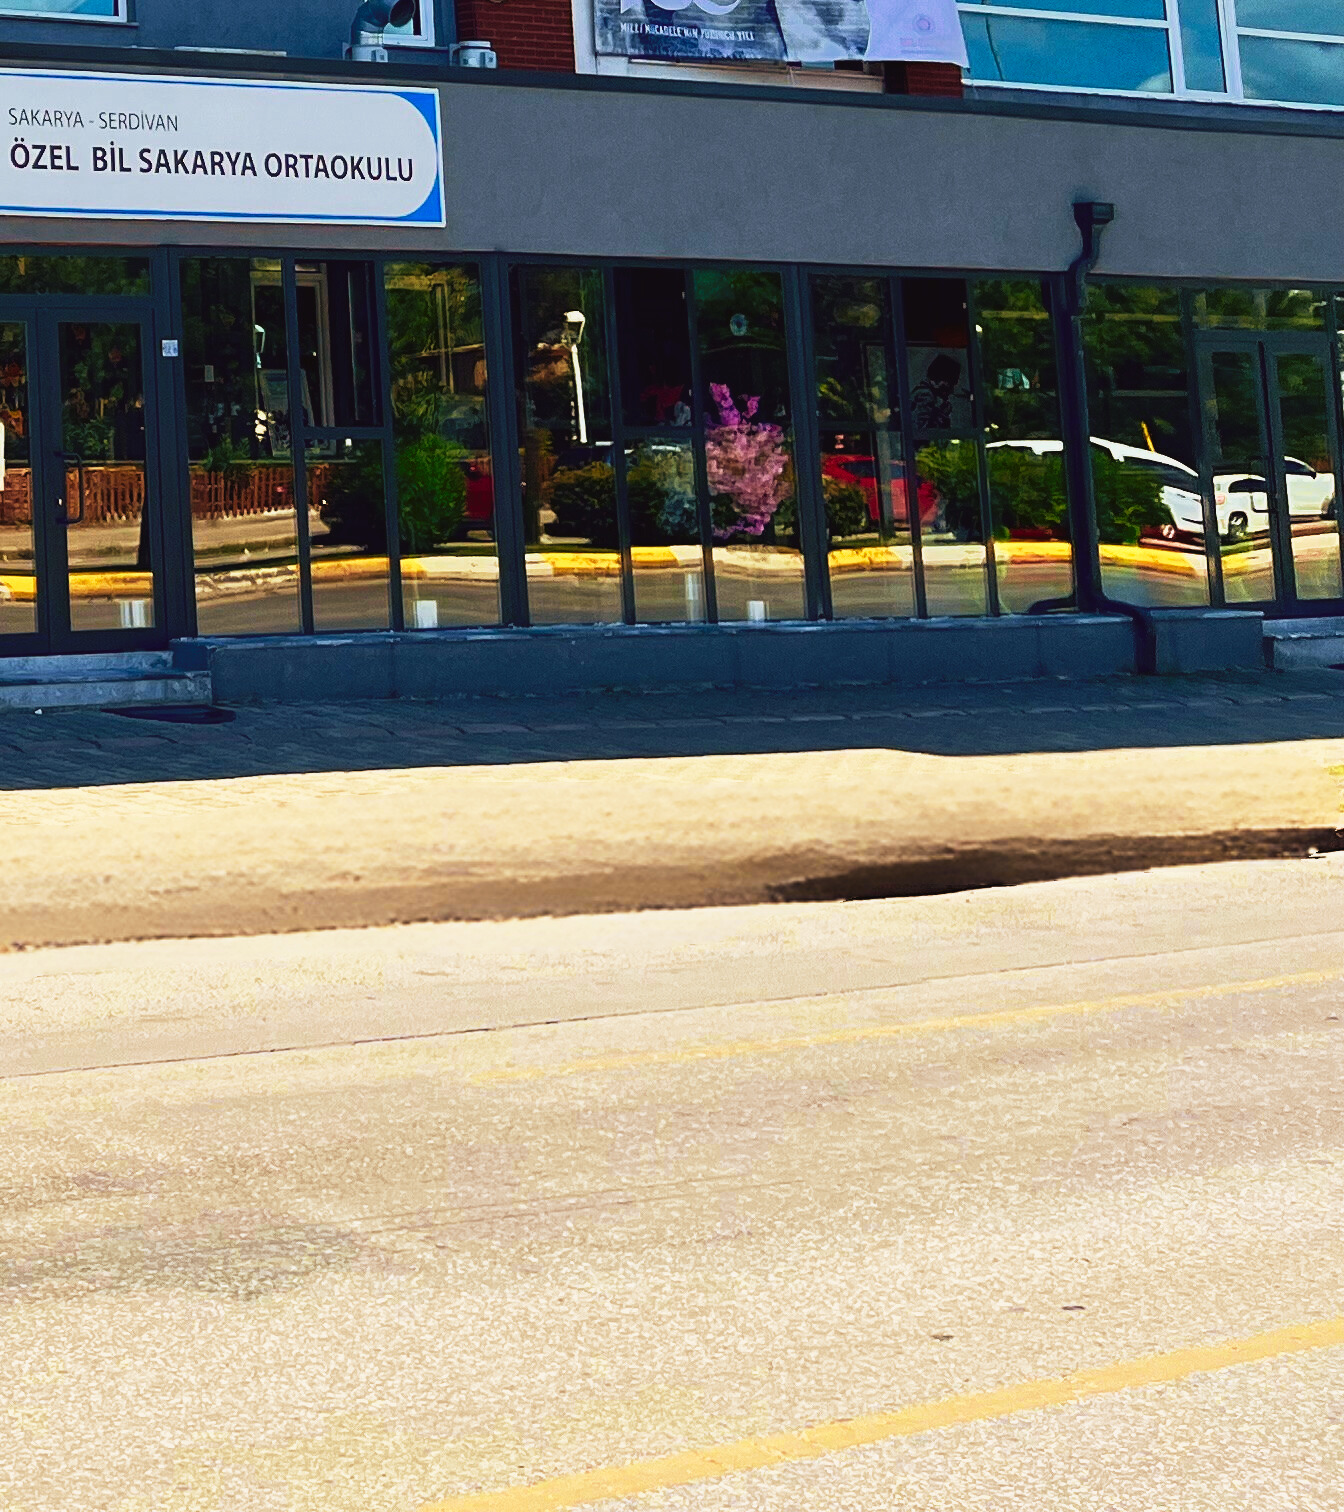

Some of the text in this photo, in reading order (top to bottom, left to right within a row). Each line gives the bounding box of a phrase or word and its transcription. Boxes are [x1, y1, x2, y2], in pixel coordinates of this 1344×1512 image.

[8, 107, 85, 129] SAKARYA
[98, 110, 179, 132] SERDİVAN
[10, 136, 414, 182] ÖZEL BİL SAKARYA ORTAOKULU
